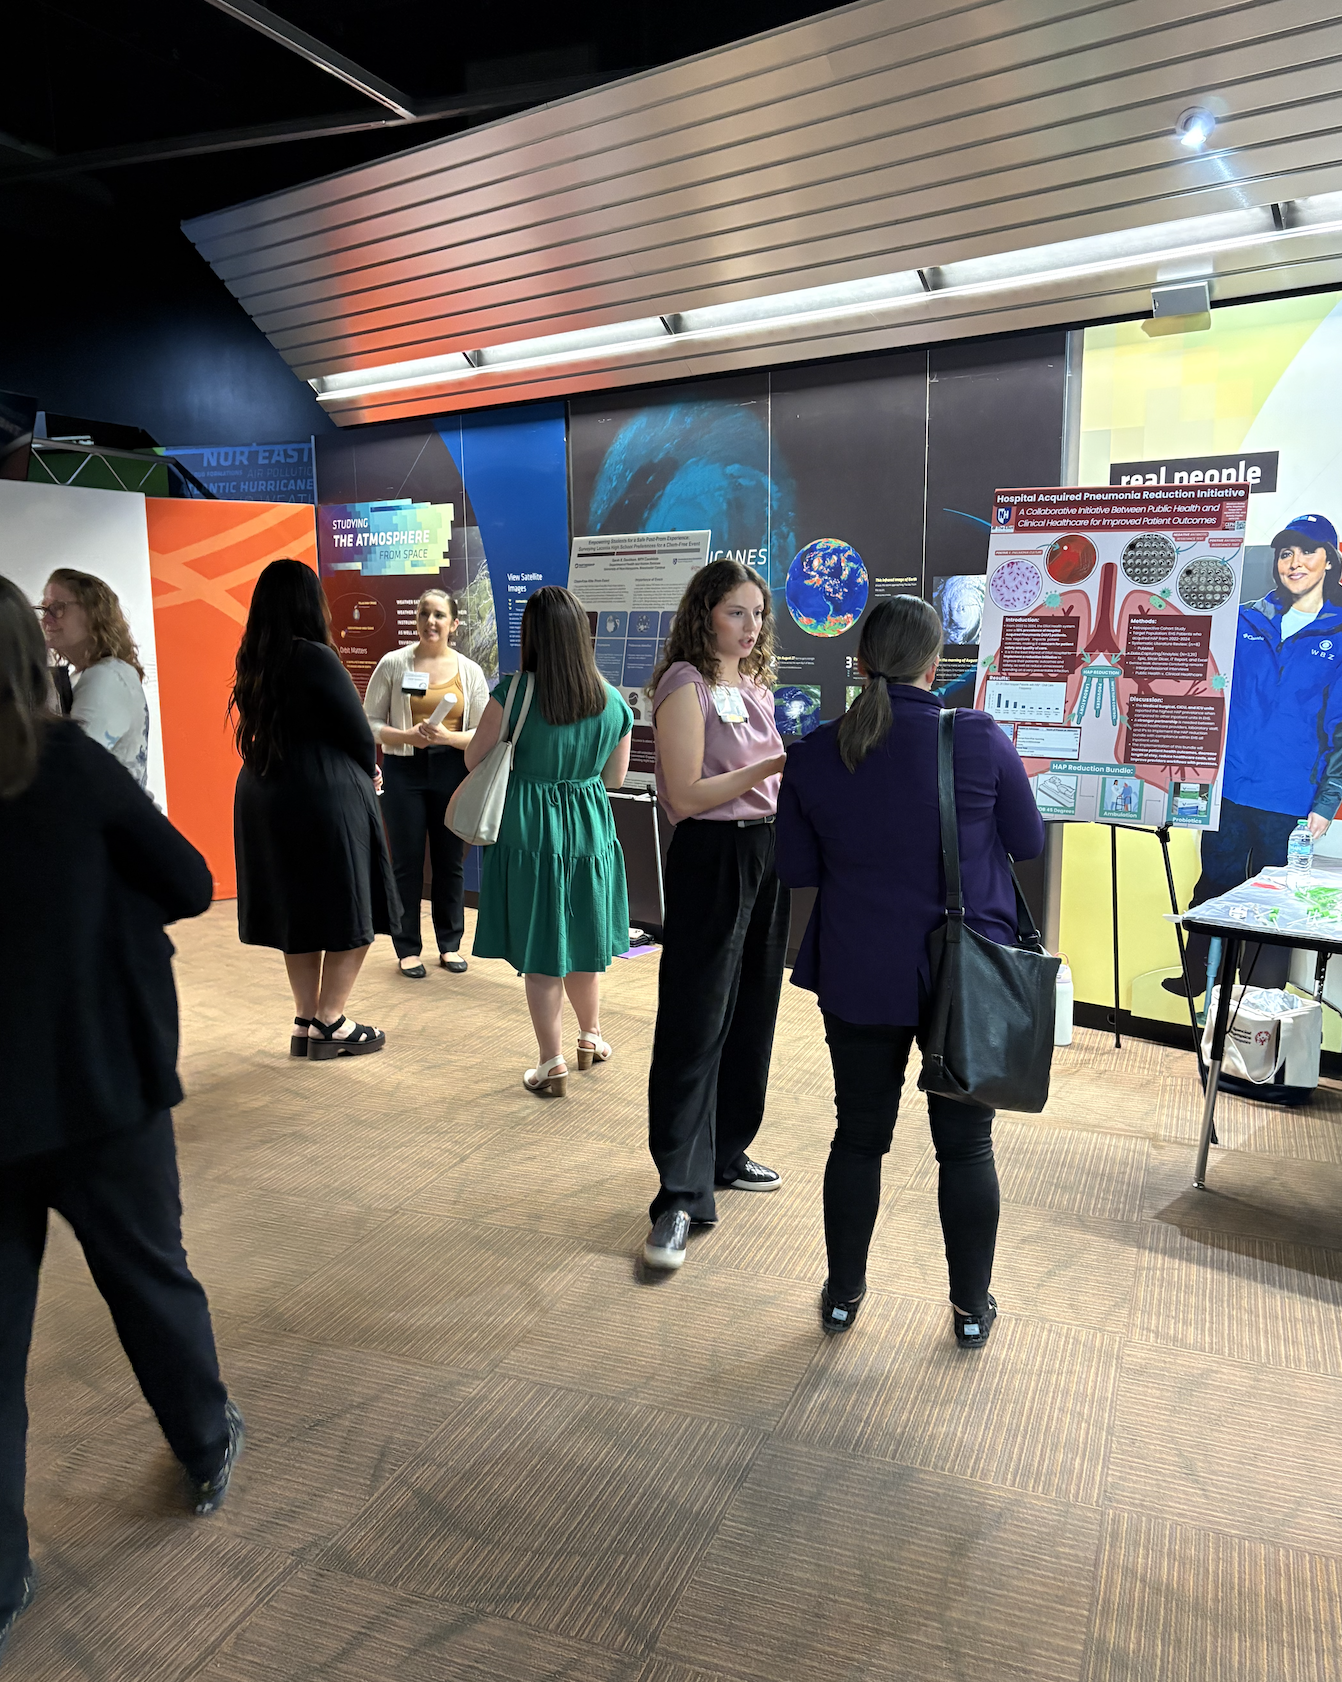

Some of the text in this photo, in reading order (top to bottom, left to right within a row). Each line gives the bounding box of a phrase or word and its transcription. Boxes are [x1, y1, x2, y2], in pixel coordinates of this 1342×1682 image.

[247, 469, 263, 478] AIR
[1121, 460, 1261, 485] real people
[997, 487, 1245, 504] Hospital Acquired Pneumonia Reduction Initiative
[1026, 506, 1077, 515] Collaborative
[1078, 506, 1109, 515] Initiative
[1111, 505, 1146, 514] Between
[1147, 504, 1172, 513] Public
[1173, 504, 1200, 513] Health
[1202, 503, 1220, 512] and
[332, 518, 368, 530] STUDYING
[1017, 519, 1045, 528] Clinical
[1046, 518, 1089, 527] Healthcare
[1090, 518, 1101, 526] for
[1102, 517, 1140, 528] Improved
[1142, 516, 1171, 526] Patient
[1172, 516, 1216, 525] Outcomes
[333, 530, 430, 548] THE ATMOSPHERE
[380, 549, 428, 560] FROM SPACE
[507, 572, 543, 581] View Satellite
[508, 584, 527, 594] Images
[340, 646, 368, 655] Orbit Matters
[1311, 648, 1335, 661] WBZ
[769, 655, 776, 667] 2
[845, 656, 852, 669] 3
[1079, 683, 1091, 715] LABORATORY
[1052, 762, 1133, 775] HAP Reduction Bundle:
[1103, 811, 1138, 819] Ambulation
[1172, 816, 1202, 824] Probiotics
